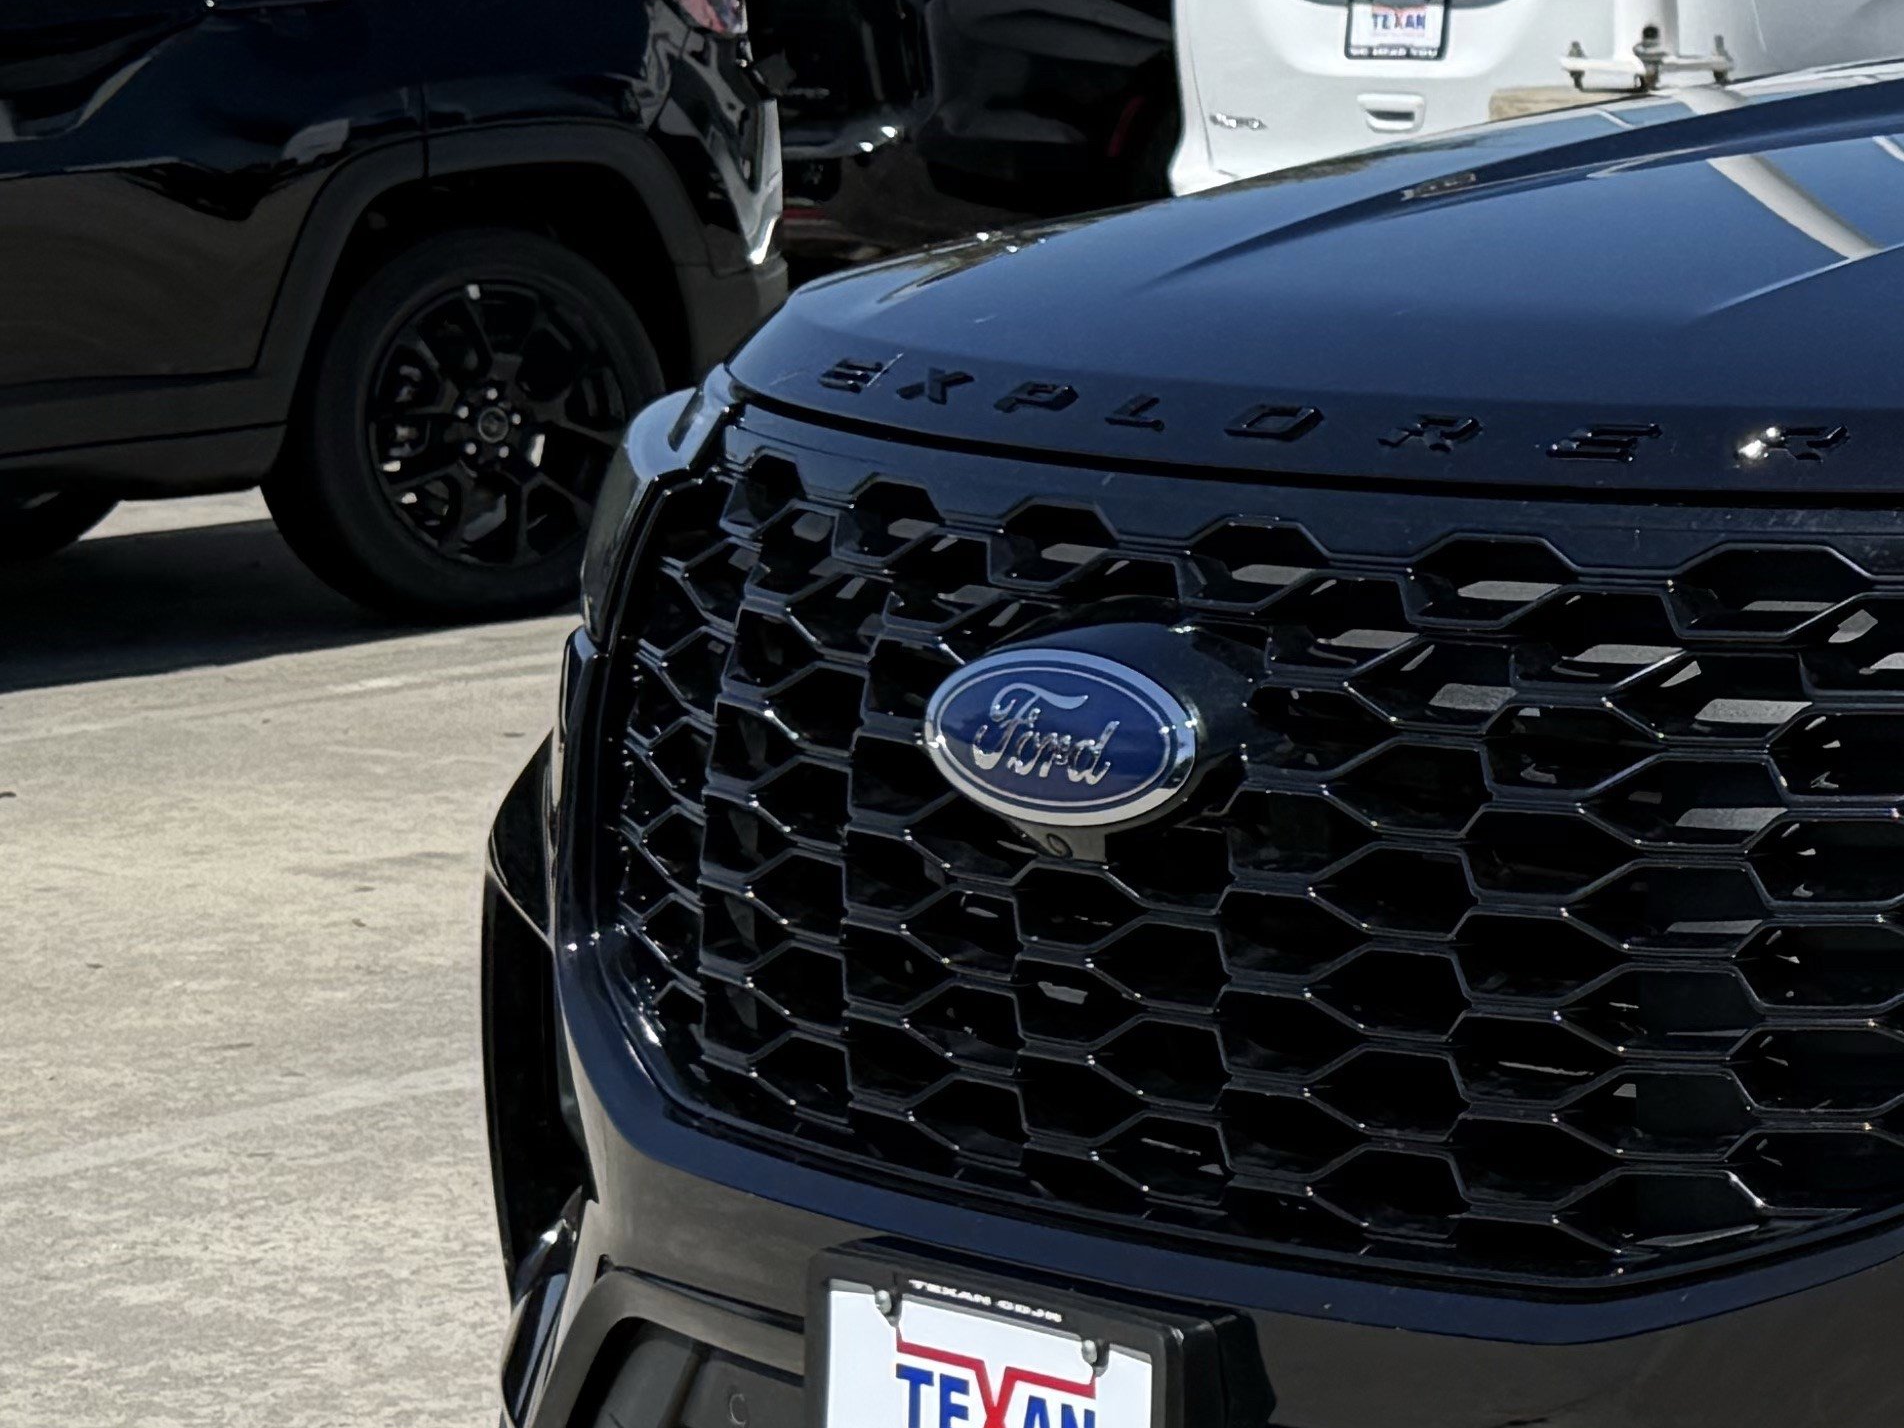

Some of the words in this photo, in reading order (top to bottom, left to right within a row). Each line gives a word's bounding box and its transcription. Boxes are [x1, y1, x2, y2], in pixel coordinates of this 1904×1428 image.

[818, 355, 1848, 464] EXPLORER
[972, 682, 1121, 785] Ford
[908, 1279, 991, 1306] TEXAN
